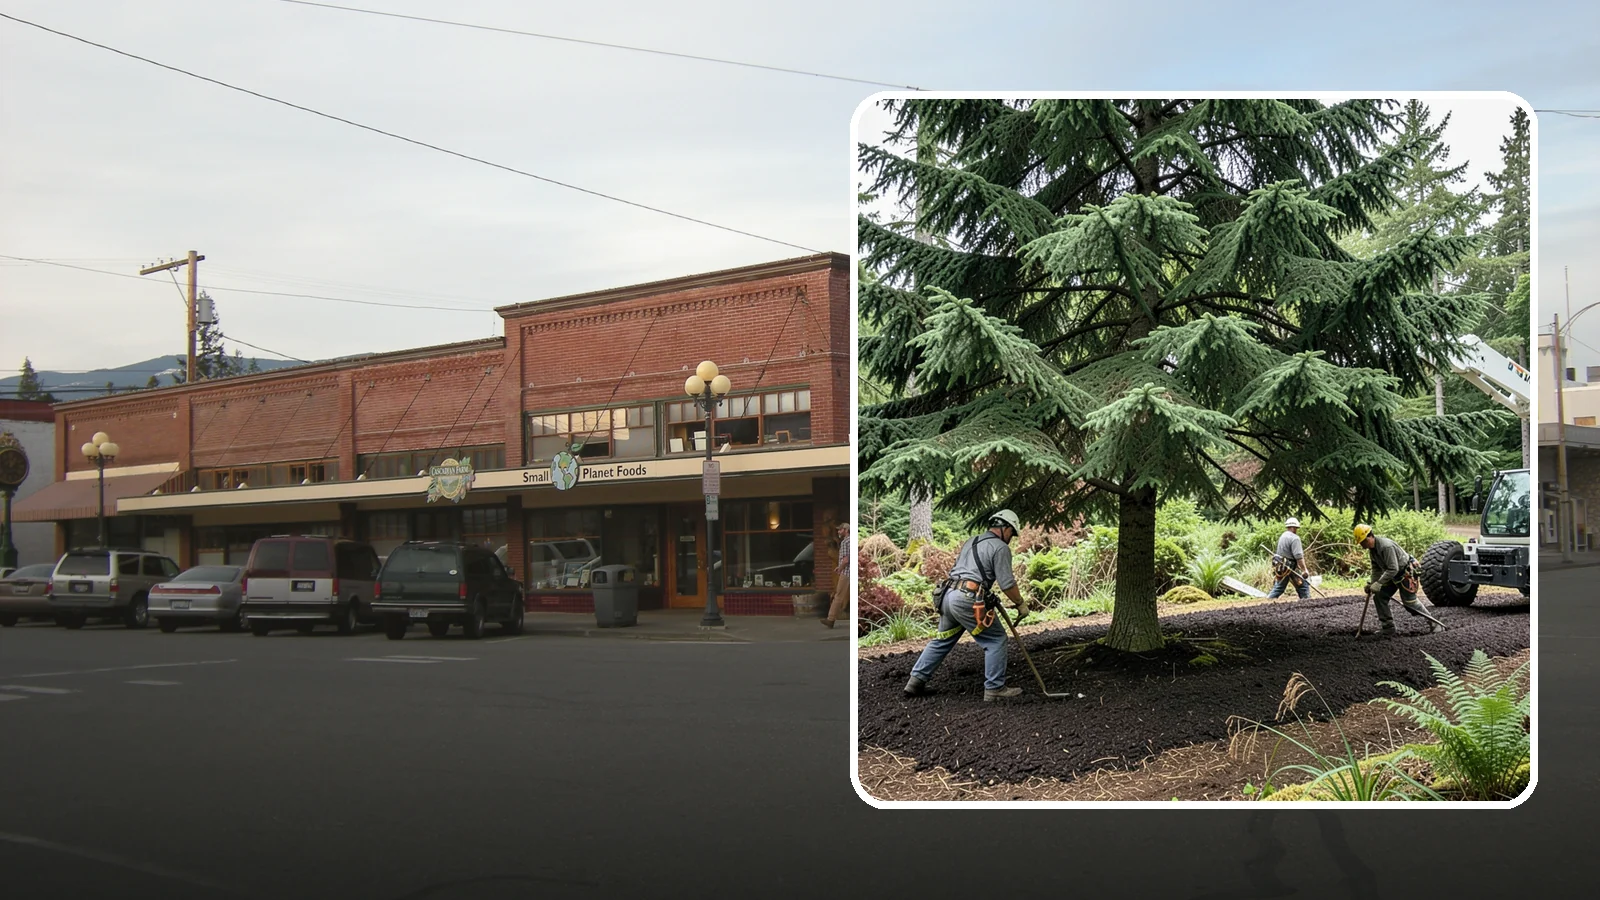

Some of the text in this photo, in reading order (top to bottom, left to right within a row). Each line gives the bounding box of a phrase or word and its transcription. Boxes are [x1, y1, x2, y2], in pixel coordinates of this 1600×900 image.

[523, 464, 647, 483] Small Planet Foods
